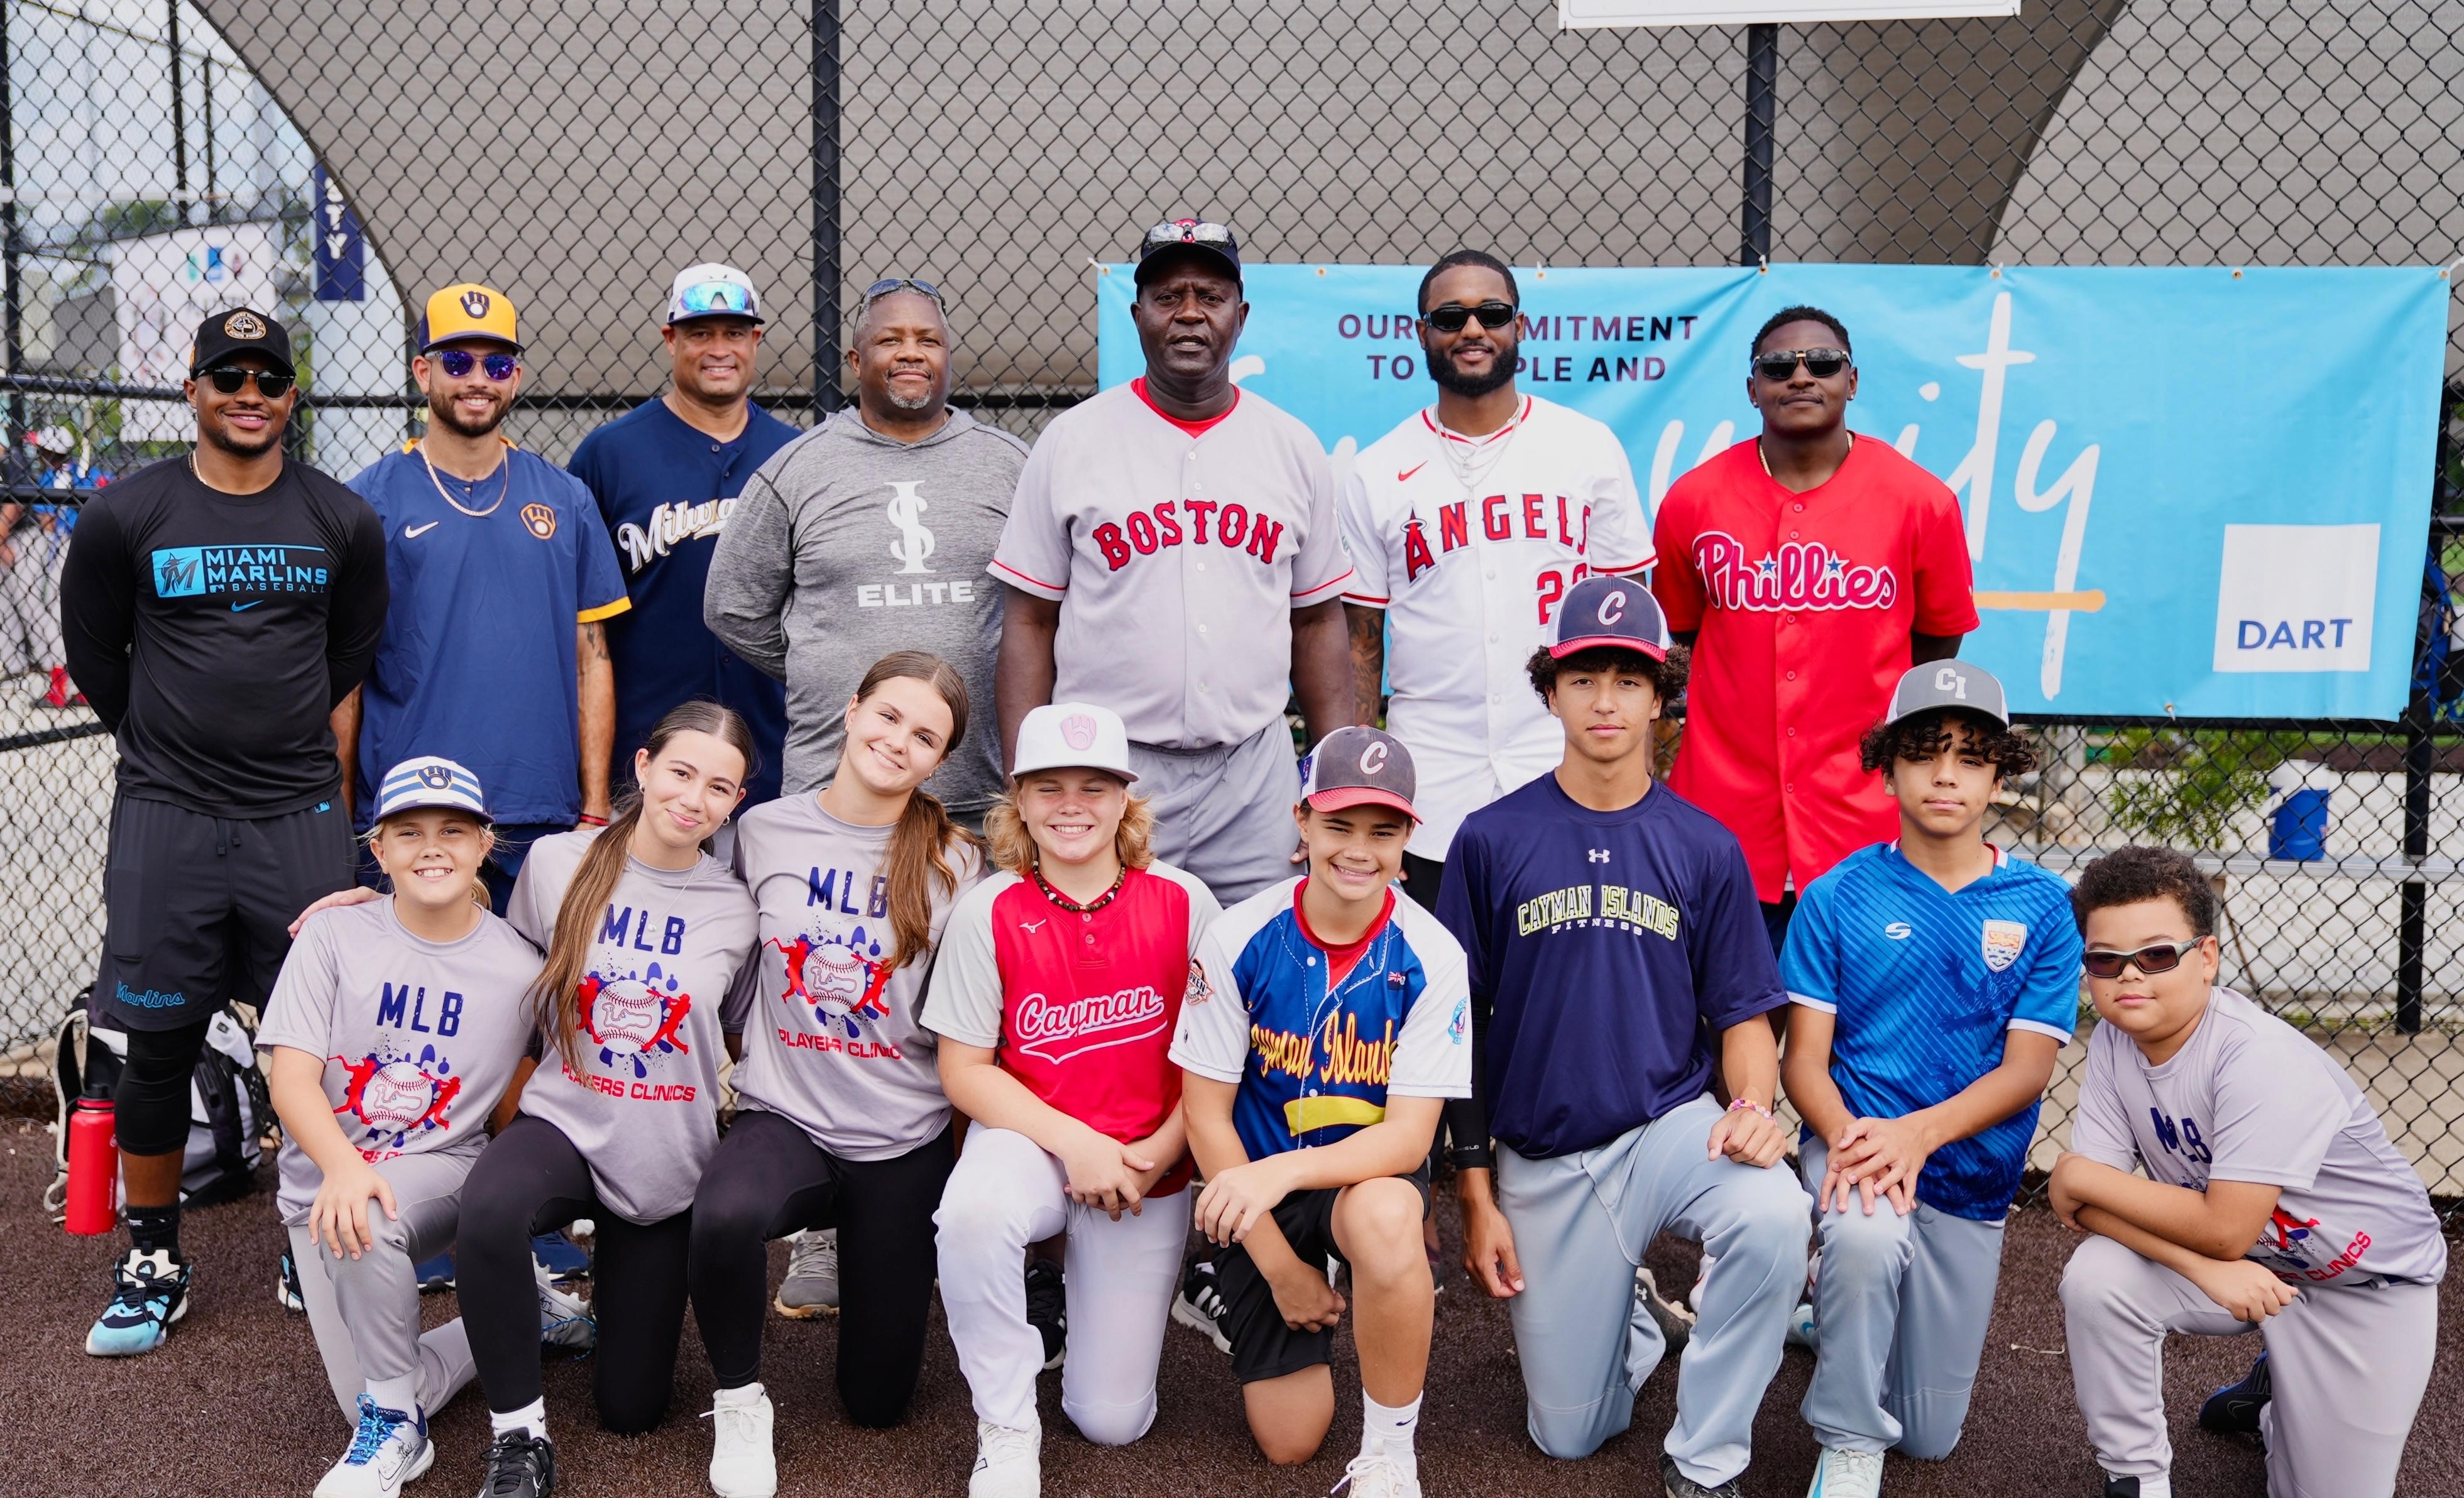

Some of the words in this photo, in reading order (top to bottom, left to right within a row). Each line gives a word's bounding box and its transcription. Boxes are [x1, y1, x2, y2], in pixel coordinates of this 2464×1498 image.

[1339, 314, 1413, 339] OUR
[1522, 316, 1698, 341] MITMENT
[1367, 354, 1414, 380] TO
[1586, 357, 1665, 382] AND
[617, 498, 738, 574] Milwa
[1092, 499, 1284, 571] BOSTON
[205, 549, 286, 566] MIAMI
[1692, 530, 1897, 612] Phillies
[207, 566, 328, 585] MARLINS
[232, 582, 325, 593] BASEBALL
[857, 580, 975, 608] ELITE
[1537, 562, 1587, 626] 2
[1597, 591, 1626, 625] C
[2237, 618, 2353, 650] DART
[1935, 668, 1966, 699] CI
[1359, 741, 1388, 775] C
[807, 867, 887, 919] MLB
[598, 903, 686, 955] MLB
[1517, 885, 1592, 937] CAYMAN
[1601, 884, 1680, 941] ISLANDS
[1551, 917, 1643, 936] FITNESS
[116, 980, 185, 1009] Marlins
[376, 982, 464, 1037] MLB
[1016, 985, 1164, 1040] Cayman
[1249, 1022, 1316, 1080] ayman
[1320, 1009, 1399, 1086] Island
[630, 1082, 696, 1102] CLINICS
[2304, 1231, 2372, 1281] CLINICS
